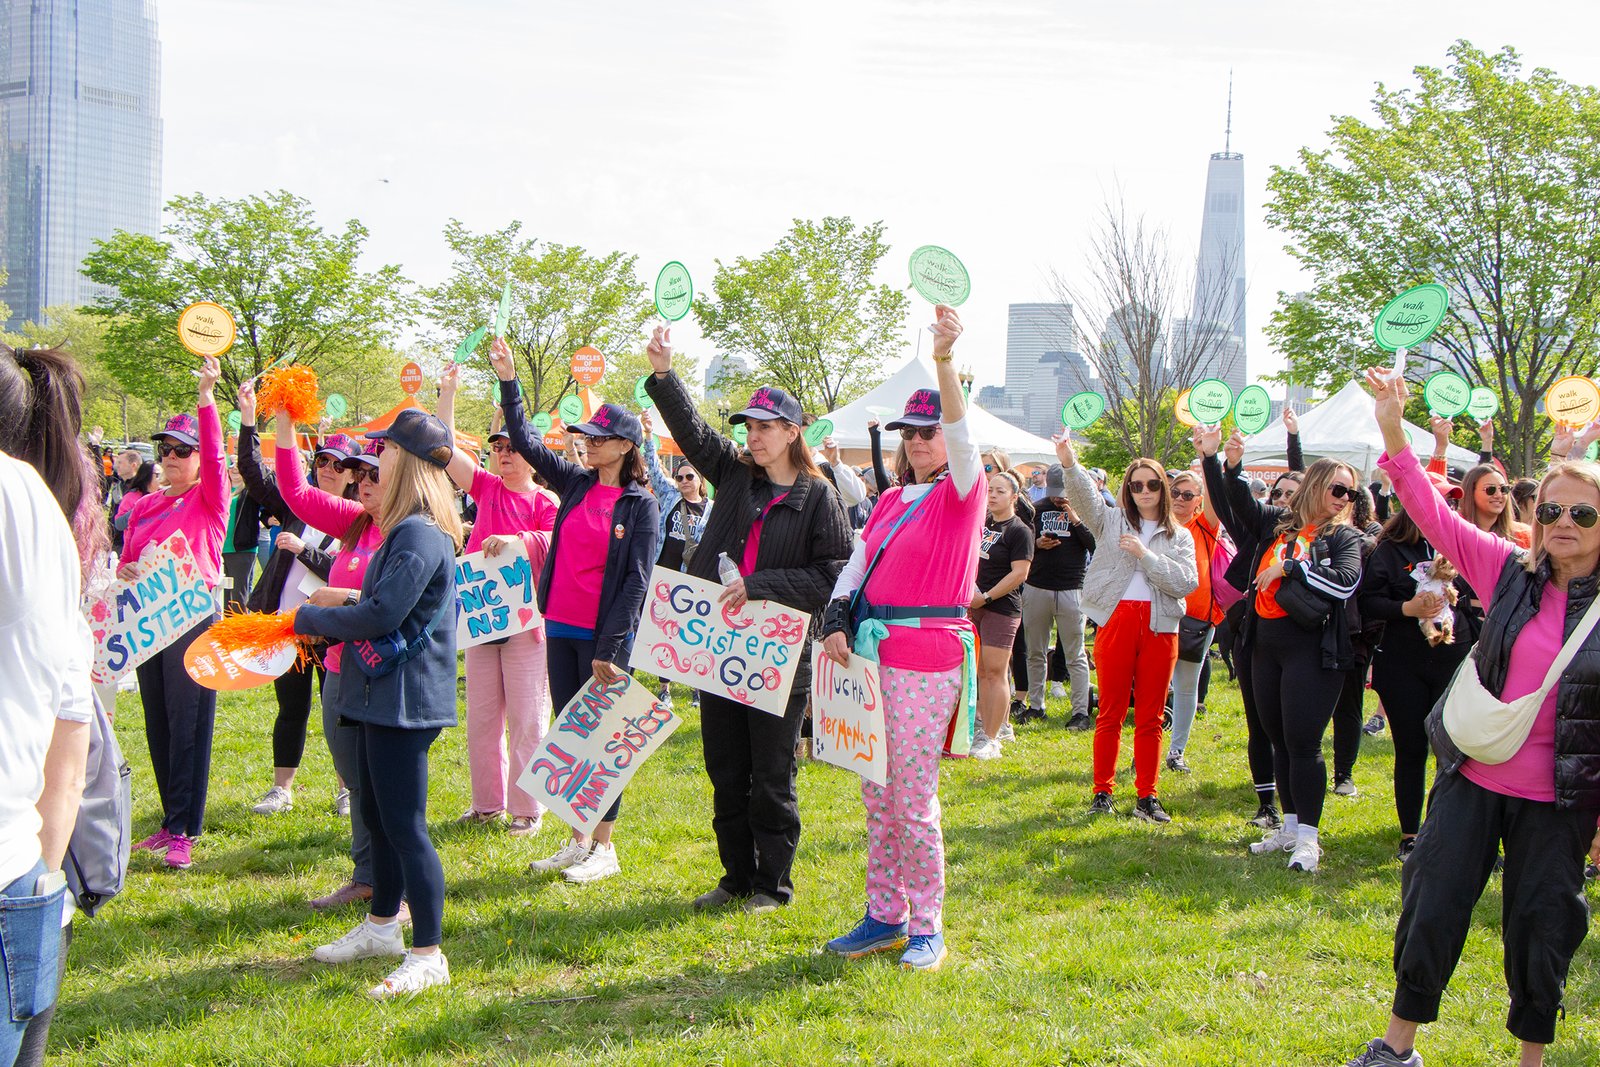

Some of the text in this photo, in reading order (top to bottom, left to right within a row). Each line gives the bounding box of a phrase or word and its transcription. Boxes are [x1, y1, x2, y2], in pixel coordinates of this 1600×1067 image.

[927, 259, 947, 272] walk
[196, 314, 215, 325] walk
[1386, 311, 1428, 334] MS
[1402, 301, 1424, 311] walk
[189, 322, 221, 345] MS
[1558, 390, 1577, 399] walk
[1560, 397, 1590, 416] MS
[1044, 521, 1067, 531] SQUAD
[116, 559, 179, 624] MANY
[459, 580, 502, 614] NC
[670, 584, 711, 617] Go
[106, 579, 212, 672] SISTERS
[467, 605, 510, 639] NJ
[679, 618, 789, 666] Sisters
[223, 662, 241, 680] TOP
[719, 655, 765, 691] Go
[816, 650, 876, 712] MUCHAS
[531, 673, 631, 797] 21 YEARS
[570, 701, 674, 823] MANY Sisters
